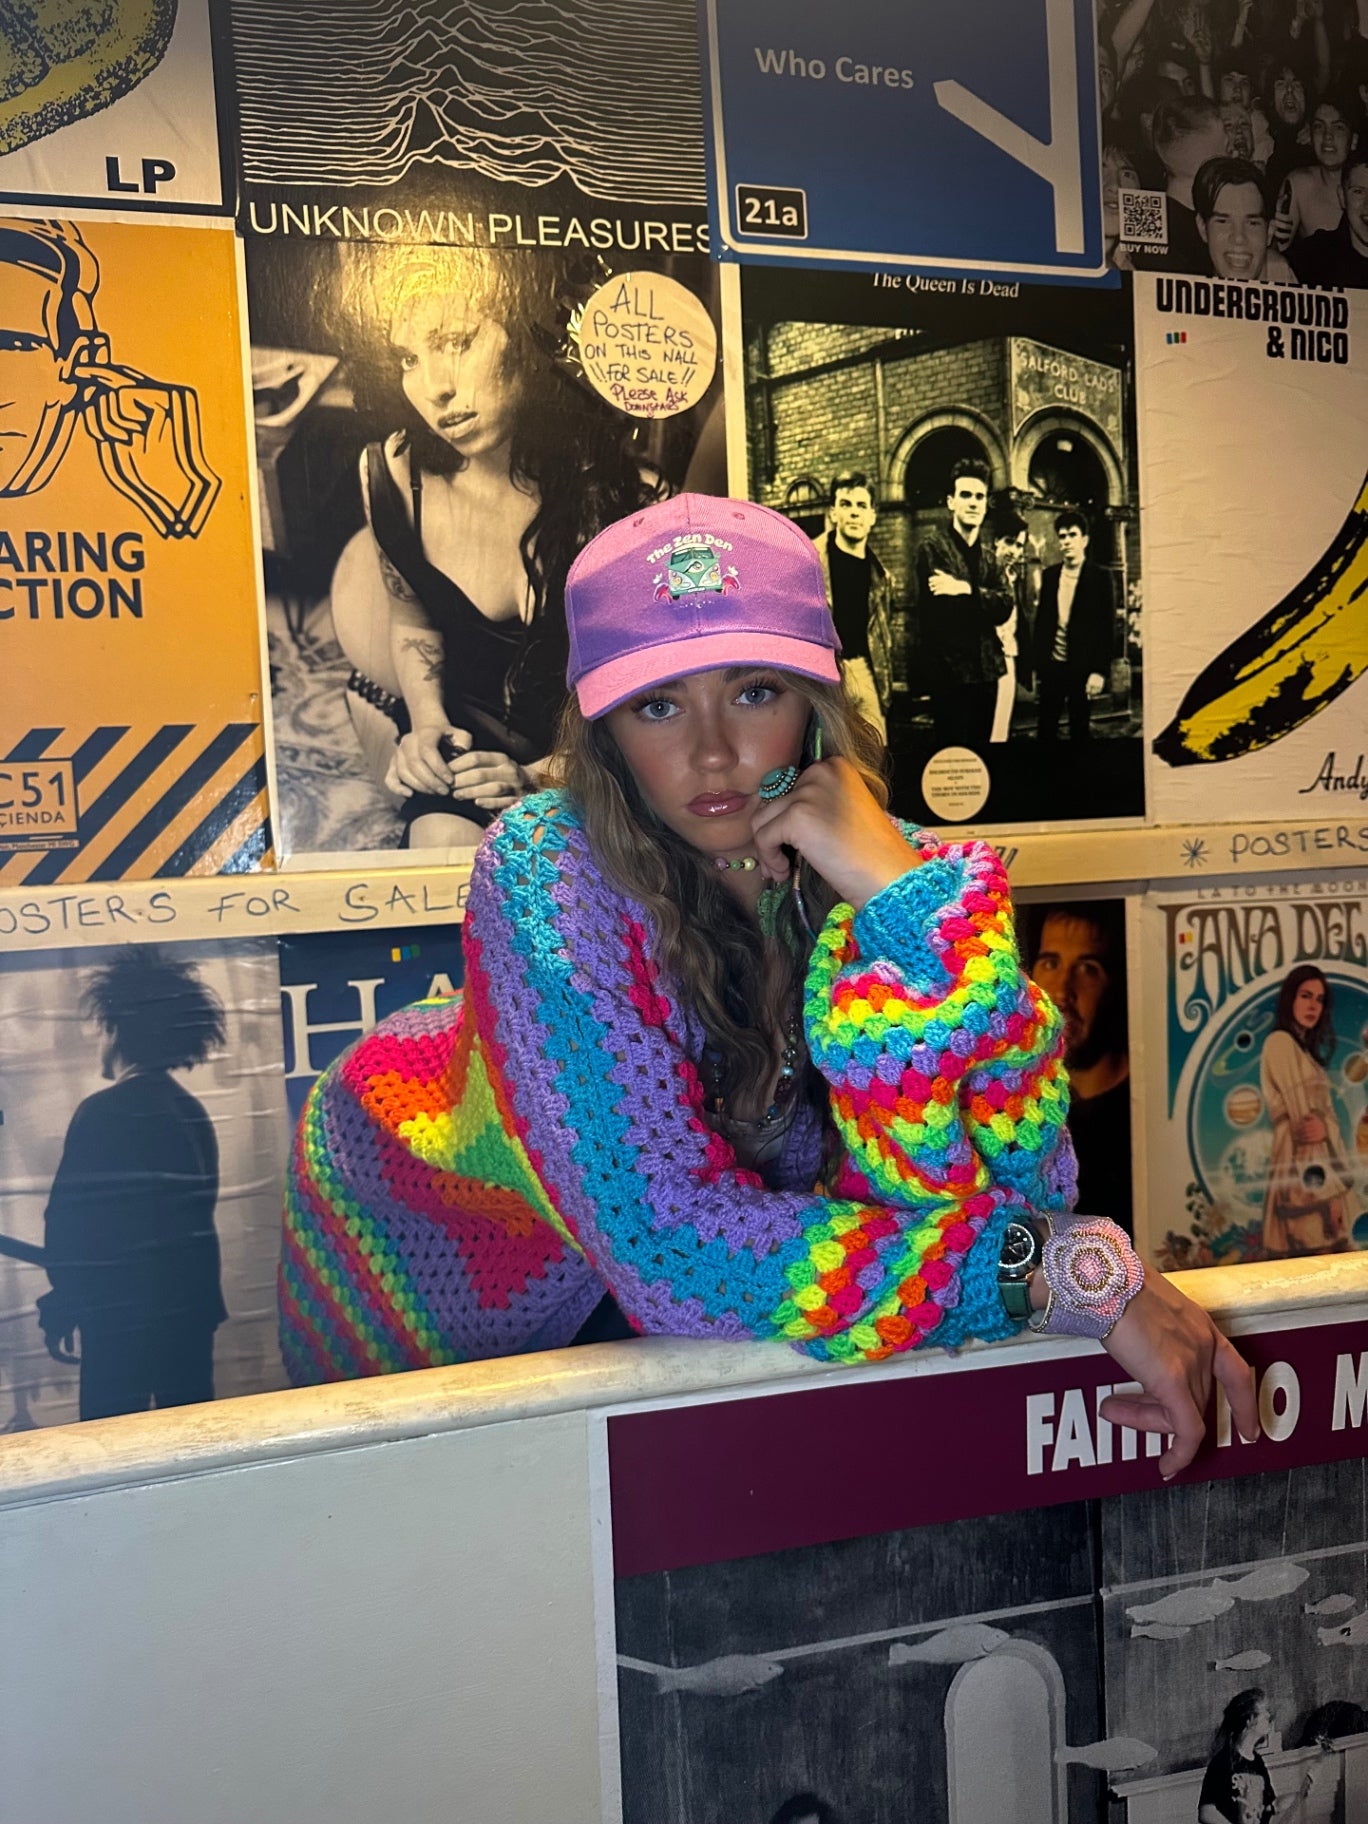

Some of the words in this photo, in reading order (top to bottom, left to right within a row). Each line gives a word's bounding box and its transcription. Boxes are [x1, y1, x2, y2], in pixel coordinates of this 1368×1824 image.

[755, 47, 826, 80] Who
[835, 56, 915, 89] Cares
[105, 156, 177, 194] LP
[249, 201, 475, 243] UNKNOWN
[488, 213, 711, 253] PLEASURES
[744, 197, 799, 226] 21a
[1120, 242, 1141, 253] BUY
[1144, 244, 1169, 255] NOW
[610, 283, 664, 320] ALL
[905, 274, 957, 293] Queen
[961, 278, 975, 294] Is
[979, 279, 1020, 298] Dead
[1156, 277, 1349, 330] UNDERGROUND
[593, 310, 694, 349] POSTERS
[1267, 325, 1285, 359] &
[1291, 327, 1349, 365] NICO
[584, 344, 607, 360] ON
[615, 344, 651, 360] THIS
[1019, 352, 1078, 382] SALFORD
[1054, 384, 1086, 405] CLUB
[0, 531, 145, 572] ARING
[646, 543, 674, 564] The
[704, 533, 734, 552] Den
[1230, 825, 1368, 863] POSTERS
[208, 889, 300, 922] FOR
[1157, 903, 1284, 1035] LANA
[1291, 901, 1368, 967] DEL
[279, 974, 456, 1079] H
[1026, 1381, 1176, 1475] FAIT
